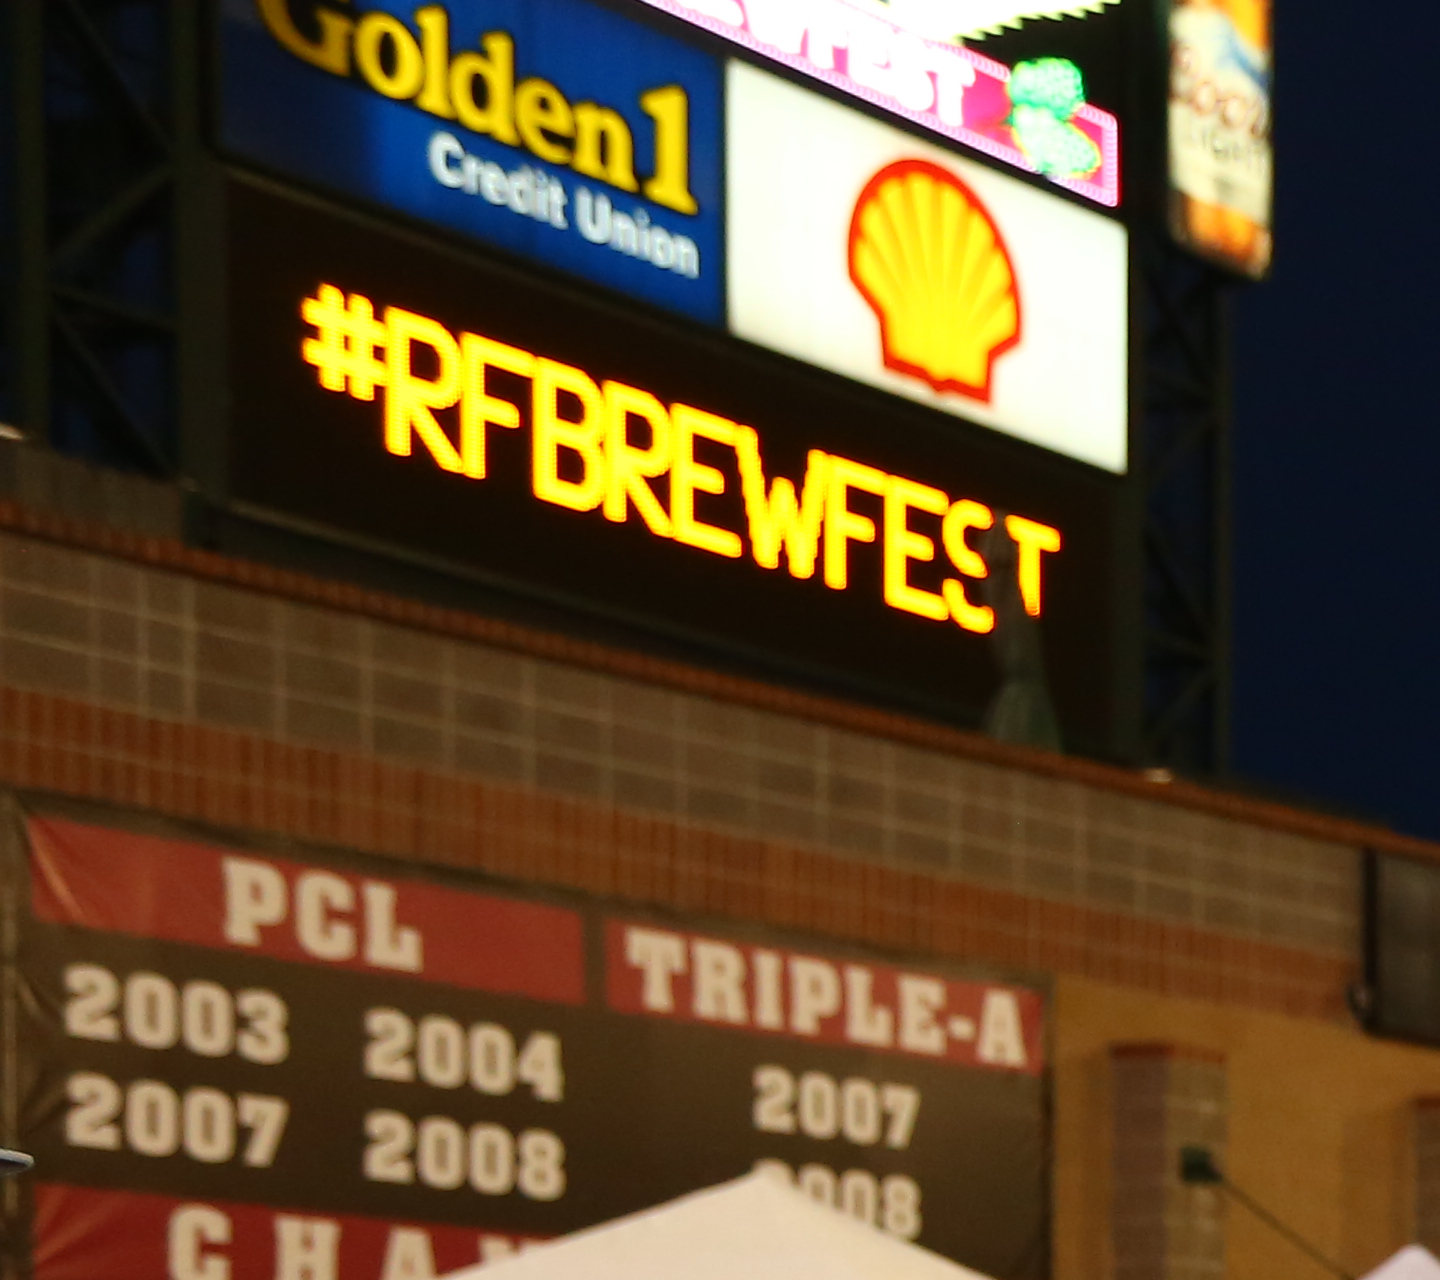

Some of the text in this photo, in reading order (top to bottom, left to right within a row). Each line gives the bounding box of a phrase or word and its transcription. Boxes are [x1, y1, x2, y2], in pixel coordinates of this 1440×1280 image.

[428, 131, 699, 279] Credit Union
[300, 282, 1061, 634] #RFBREWFEST
[222, 856, 423, 972] PCL
[64, 964, 564, 1103] 2003 2004
[625, 928, 1028, 1068] TRIPLE-A
[65, 1072, 565, 1201] 2007 2008
[752, 1063, 921, 1149] 2007
